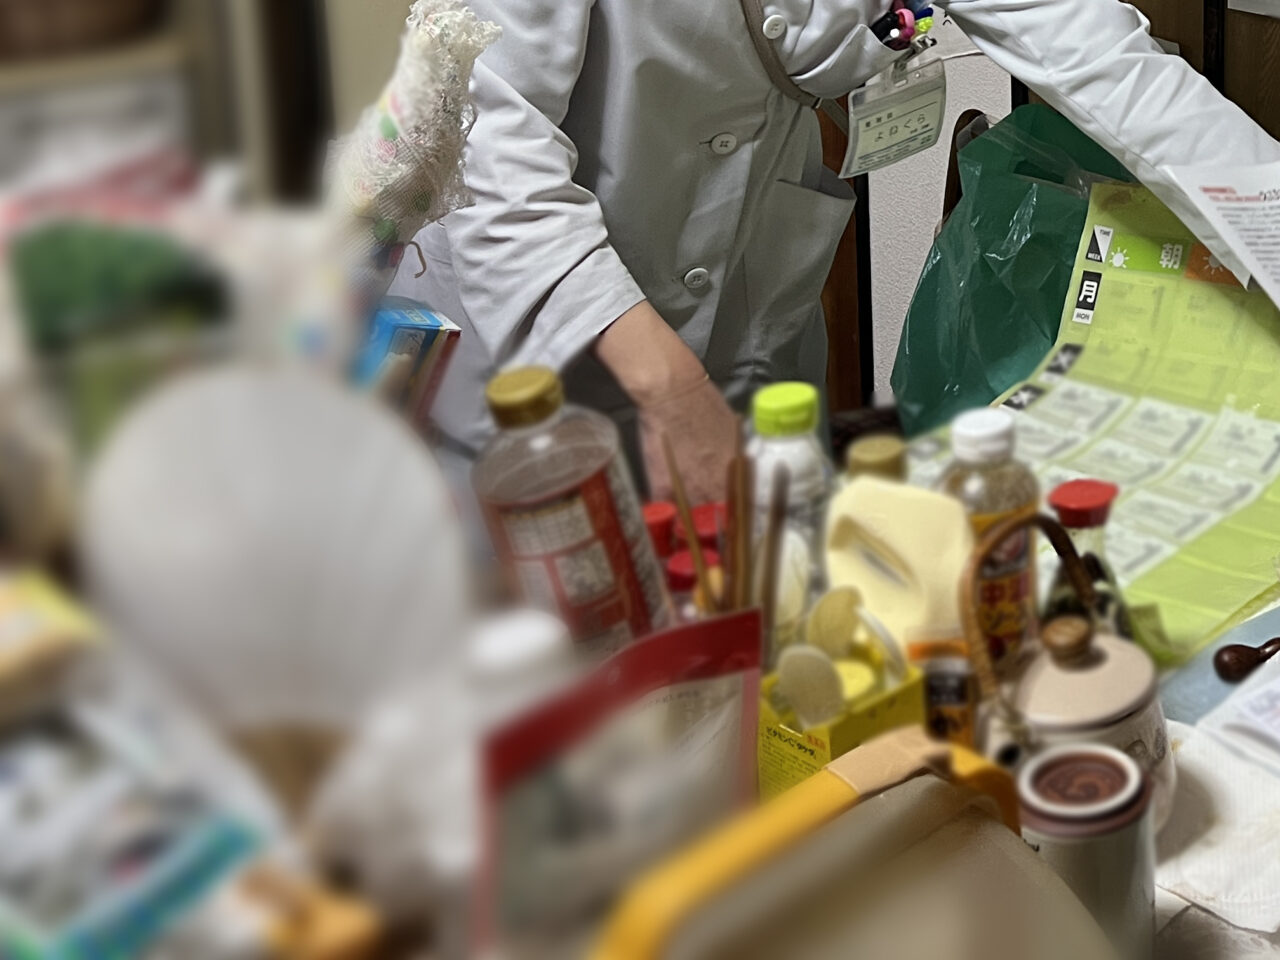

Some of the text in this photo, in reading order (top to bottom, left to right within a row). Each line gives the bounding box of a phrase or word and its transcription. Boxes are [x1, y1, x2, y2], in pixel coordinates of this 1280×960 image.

[1087, 252, 1101, 260] WEEK
[1159, 243, 1184, 269] 朝
[1078, 280, 1098, 303] 月
[1075, 312, 1090, 320] MON
